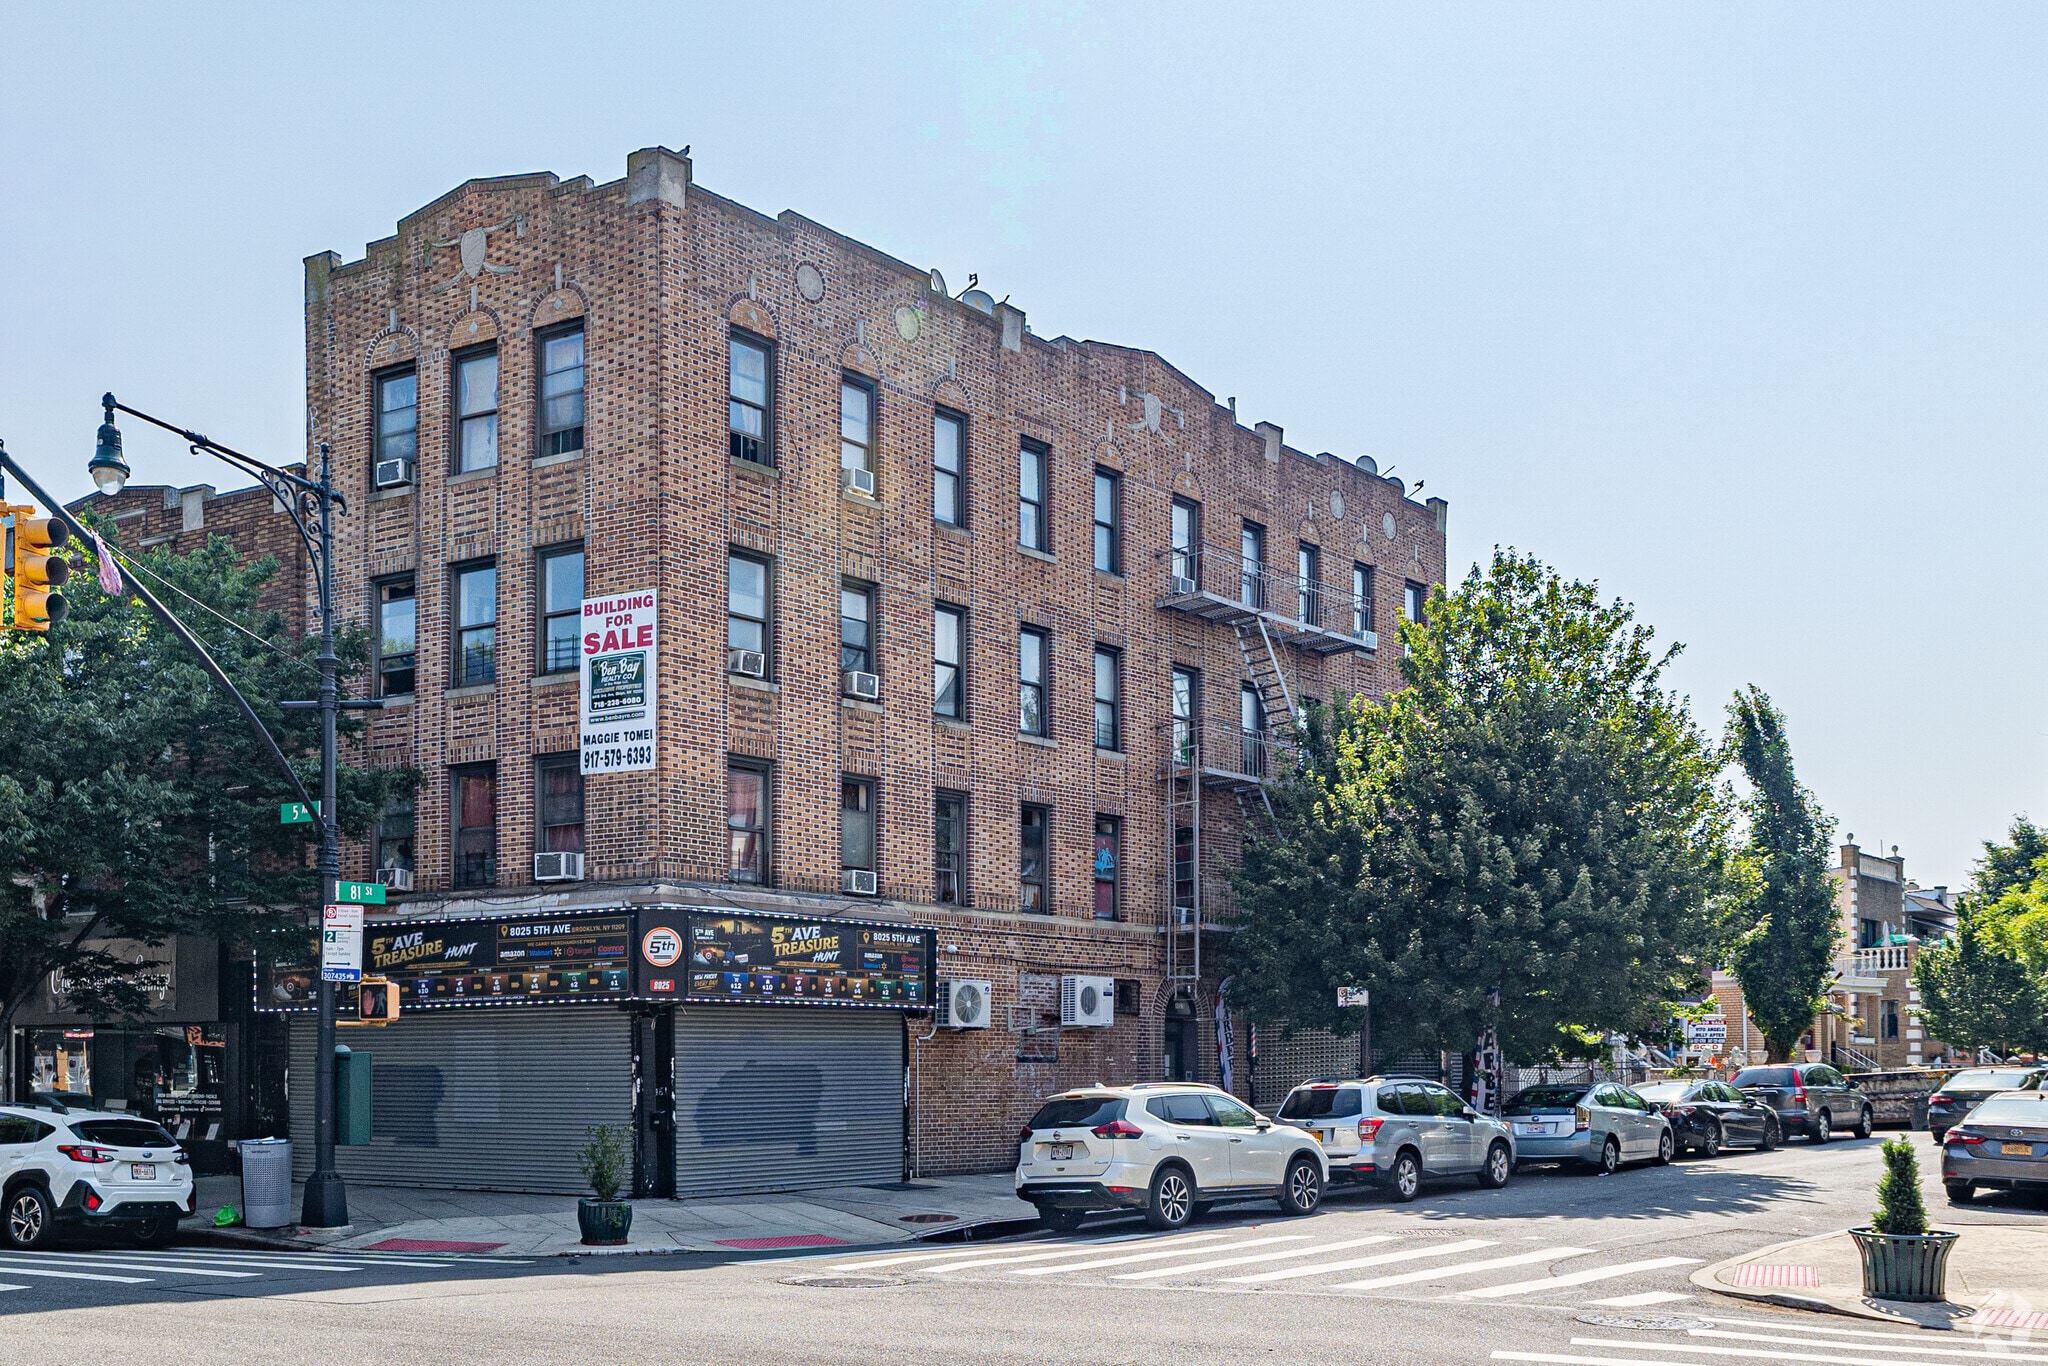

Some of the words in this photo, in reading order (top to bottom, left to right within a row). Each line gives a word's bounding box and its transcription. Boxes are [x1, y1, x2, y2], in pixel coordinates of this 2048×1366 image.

[583, 595, 653, 617] BUILDING
[605, 613, 633, 628] FOR
[583, 623, 653, 655] SALE
[600, 661, 617, 677] Ben
[619, 657, 640, 680] Bay
[601, 674, 621, 683] REALTY
[590, 711, 644, 723] www.benbayre.com
[583, 731, 619, 745] MAGGIE
[624, 729, 653, 741] TOMEI
[584, 745, 651, 769] 917-579-6393
[292, 805, 299, 821] 5
[350, 885, 361, 900] 81
[365, 887, 373, 896] St
[326, 932, 334, 942] 2
[509, 926, 531, 937] 8025
[533, 925, 551, 935] 5TH
[552, 924, 571, 934] AVE
[771, 926, 793, 944] 5TH
[791, 926, 821, 941] AVE
[873, 932, 890, 942] 8025
[892, 934, 905, 943] 5TH
[906, 935, 921, 944] AVE
[371, 937, 393, 955] 5TH
[392, 931, 423, 951] AVE
[649, 941, 676, 954] 5th
[773, 936, 839, 957] TREASURE
[373, 939, 443, 968] TREASURE
[444, 942, 478, 960] HUNT
[500, 950, 525, 958] amazon
[529, 949, 553, 957] Walmart
[575, 947, 593, 955] target
[812, 950, 841, 963] HUNT
[323, 972, 346, 980] 307435
[653, 981, 670, 990] 8025
